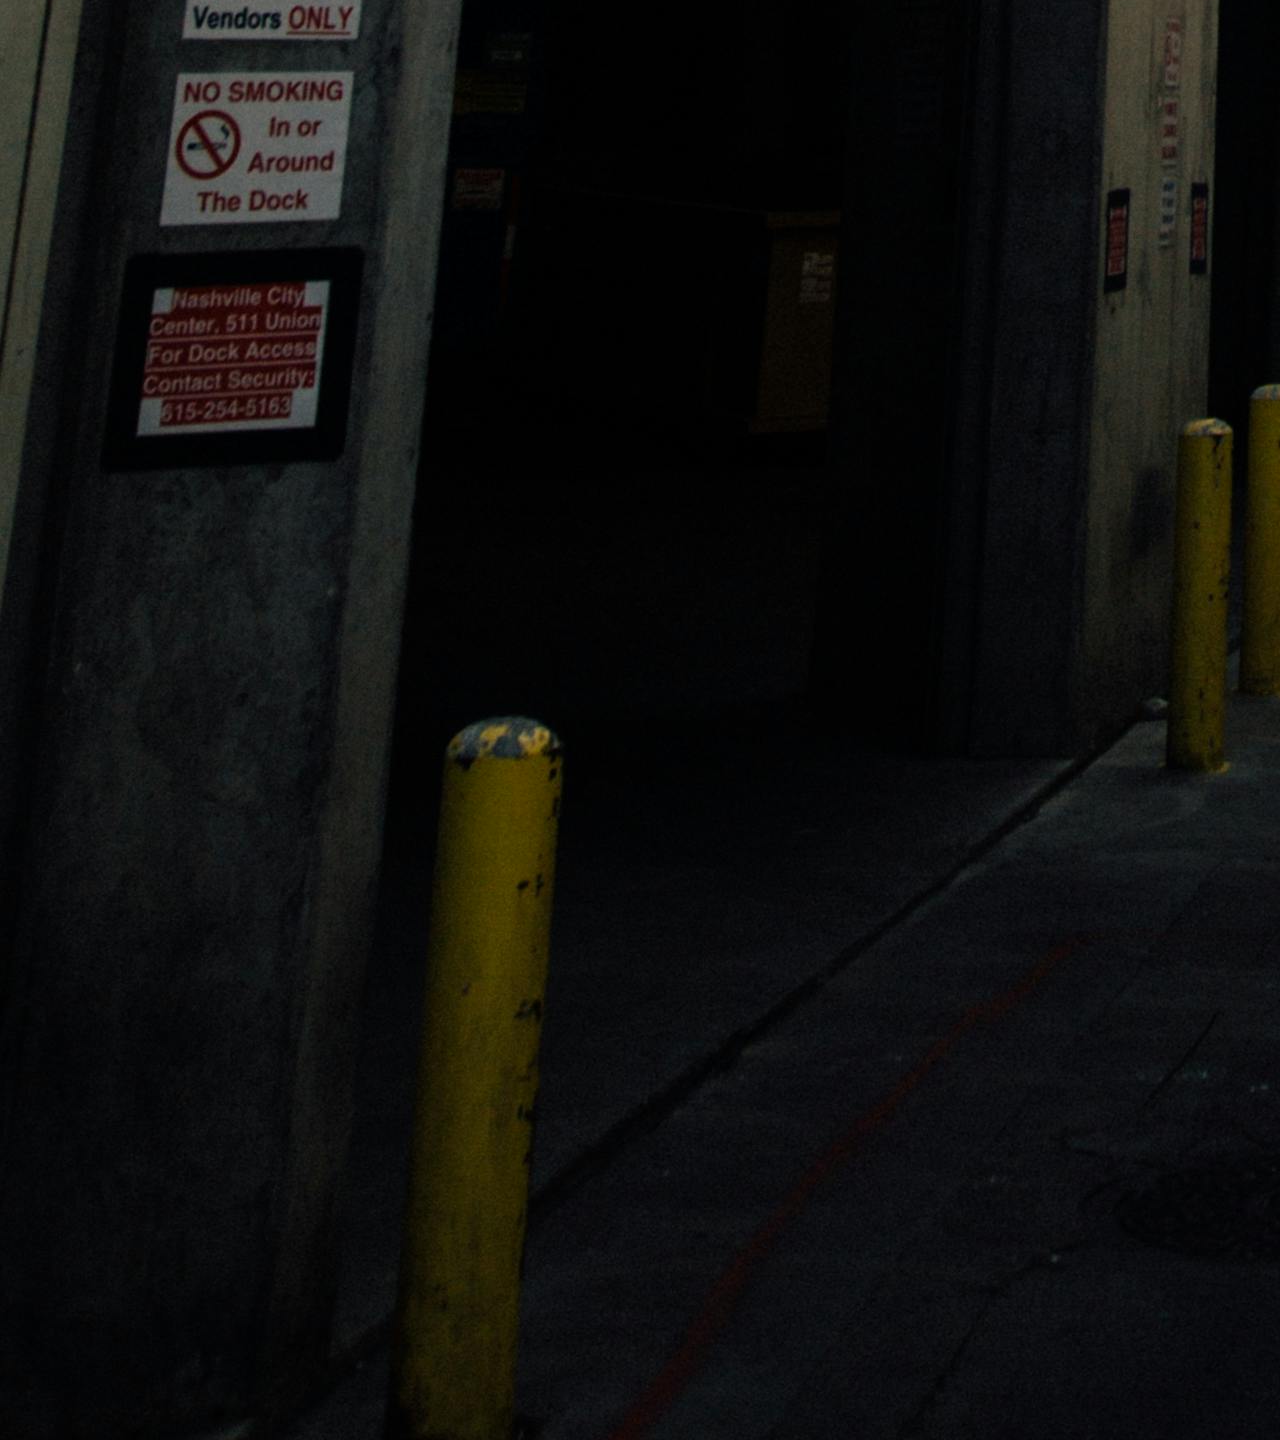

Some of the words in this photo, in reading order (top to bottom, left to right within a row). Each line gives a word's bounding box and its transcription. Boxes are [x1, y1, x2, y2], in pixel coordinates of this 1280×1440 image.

[193, 5, 282, 29] Vendors
[288, 5, 353, 30] ONLY
[184, 81, 221, 103] NO
[228, 80, 343, 102] SMOKING
[269, 117, 290, 137] In
[297, 120, 322, 136] or
[248, 150, 335, 173] Around
[197, 191, 241, 212] The
[249, 189, 308, 211] Dock
[174, 286, 262, 309] Nashville
[267, 285, 305, 308] City
[226, 314, 257, 331] 511
[266, 312, 321, 330] Union
[147, 346, 183, 364] For
[189, 343, 239, 362] Dock
[245, 340, 316, 359] Access
[143, 375, 221, 393] Contact
